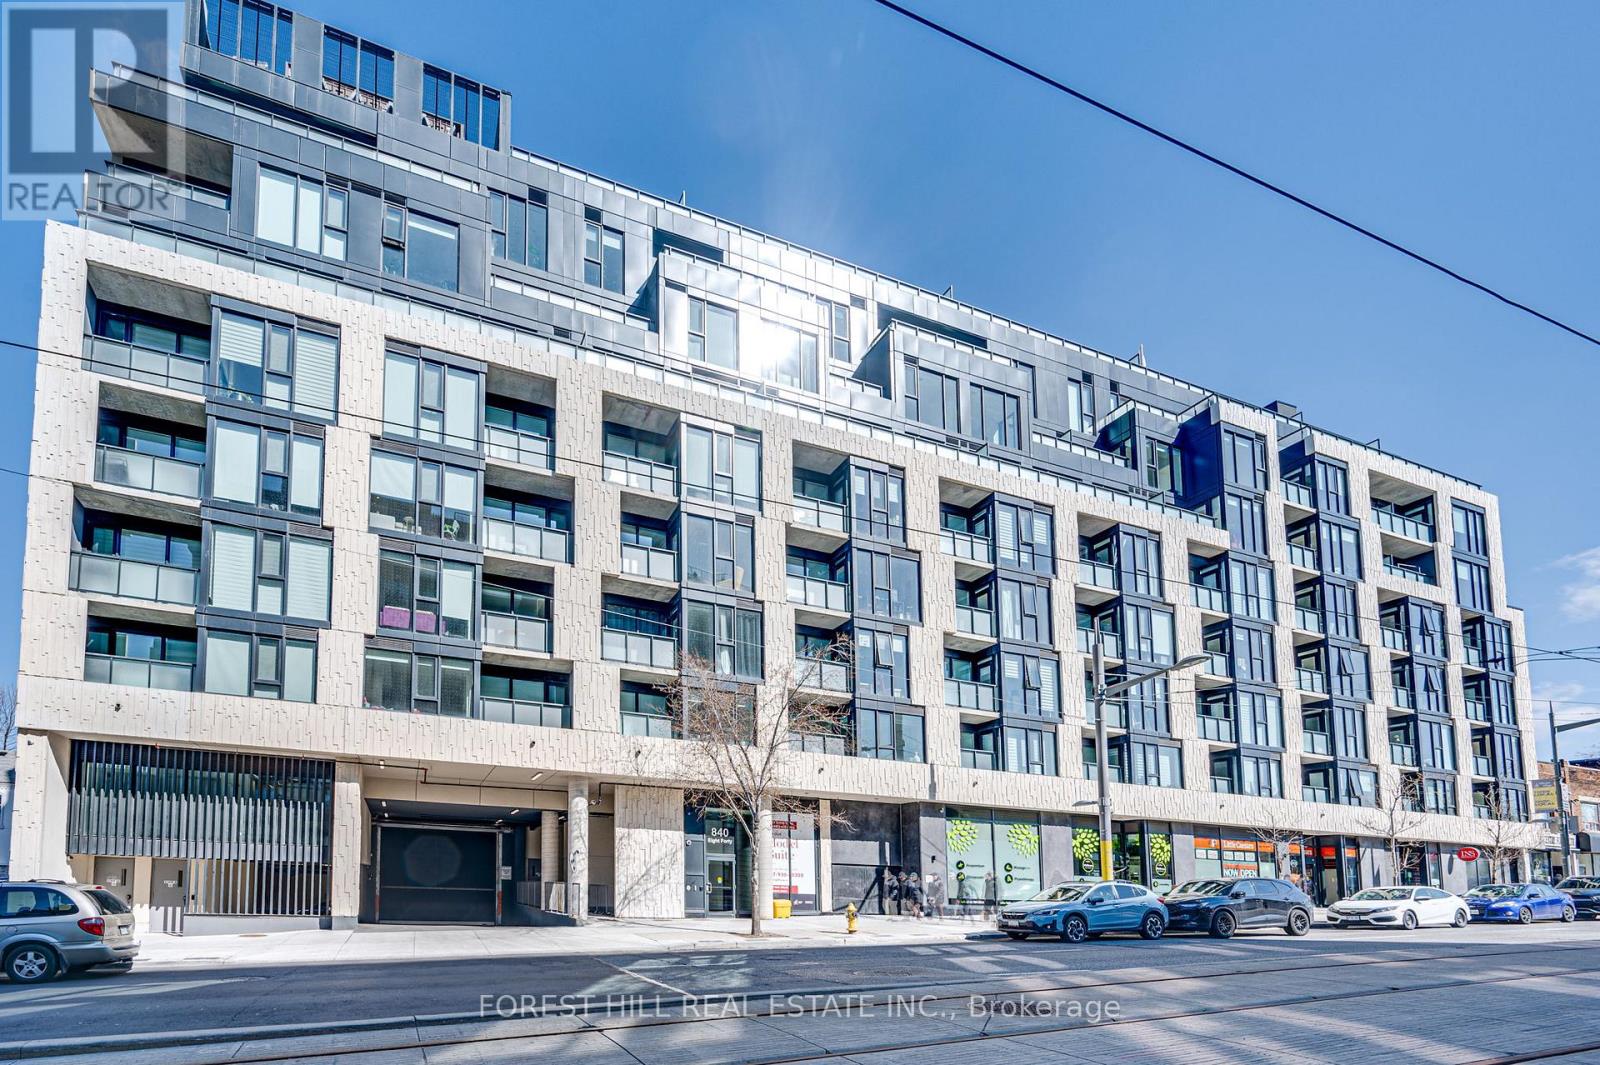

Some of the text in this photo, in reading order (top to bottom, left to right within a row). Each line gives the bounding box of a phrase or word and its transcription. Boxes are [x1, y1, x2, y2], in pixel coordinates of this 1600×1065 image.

[711, 827, 729, 837] 840
[1223, 868, 1257, 879] NOW OPEN
